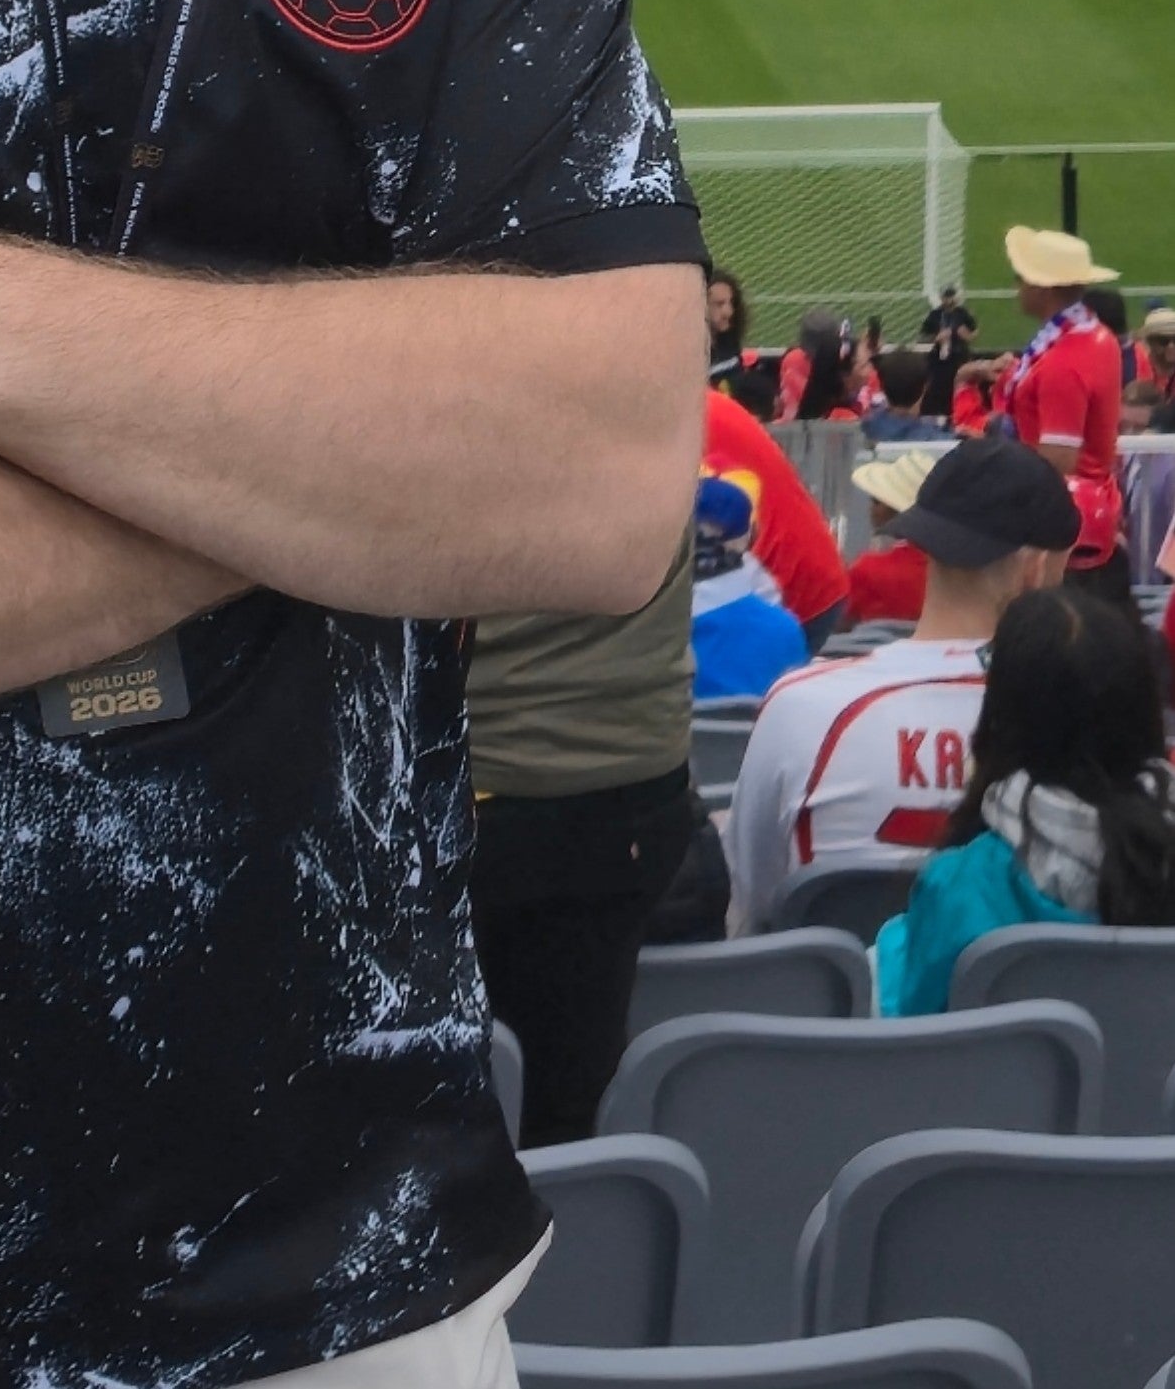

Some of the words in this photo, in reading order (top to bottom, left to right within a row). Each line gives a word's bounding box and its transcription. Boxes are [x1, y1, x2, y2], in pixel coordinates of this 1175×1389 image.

[66, 674, 124, 694] WORLD
[126, 669, 158, 685] CUP
[70, 686, 163, 722] 2026
